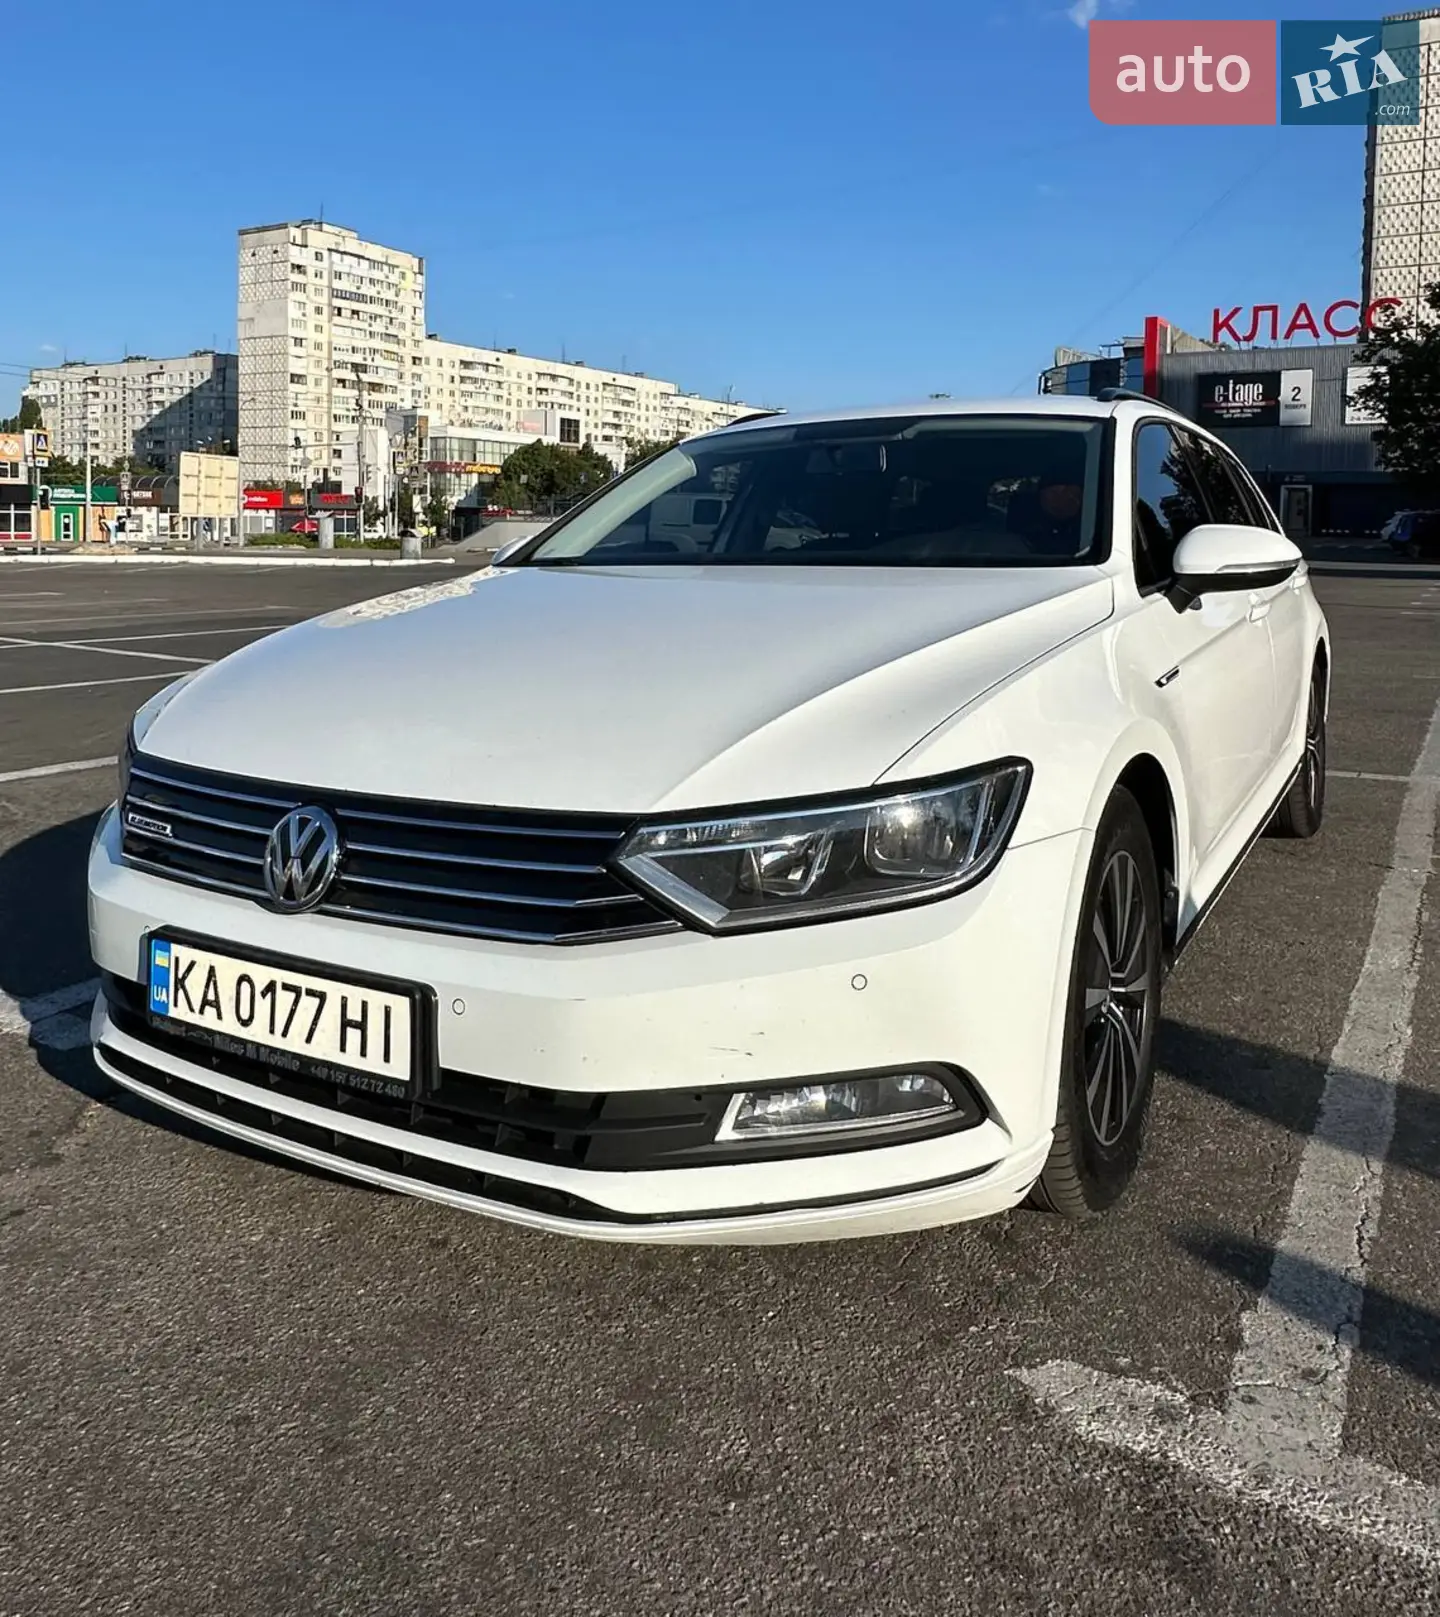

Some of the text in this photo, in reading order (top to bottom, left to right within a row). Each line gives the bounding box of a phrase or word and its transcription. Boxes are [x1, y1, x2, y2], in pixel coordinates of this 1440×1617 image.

[1214, 379, 1263, 406] e-tage
[1291, 386, 1302, 402] 2
[154, 985, 168, 1004] UA
[234, 973, 328, 1045] 0177
